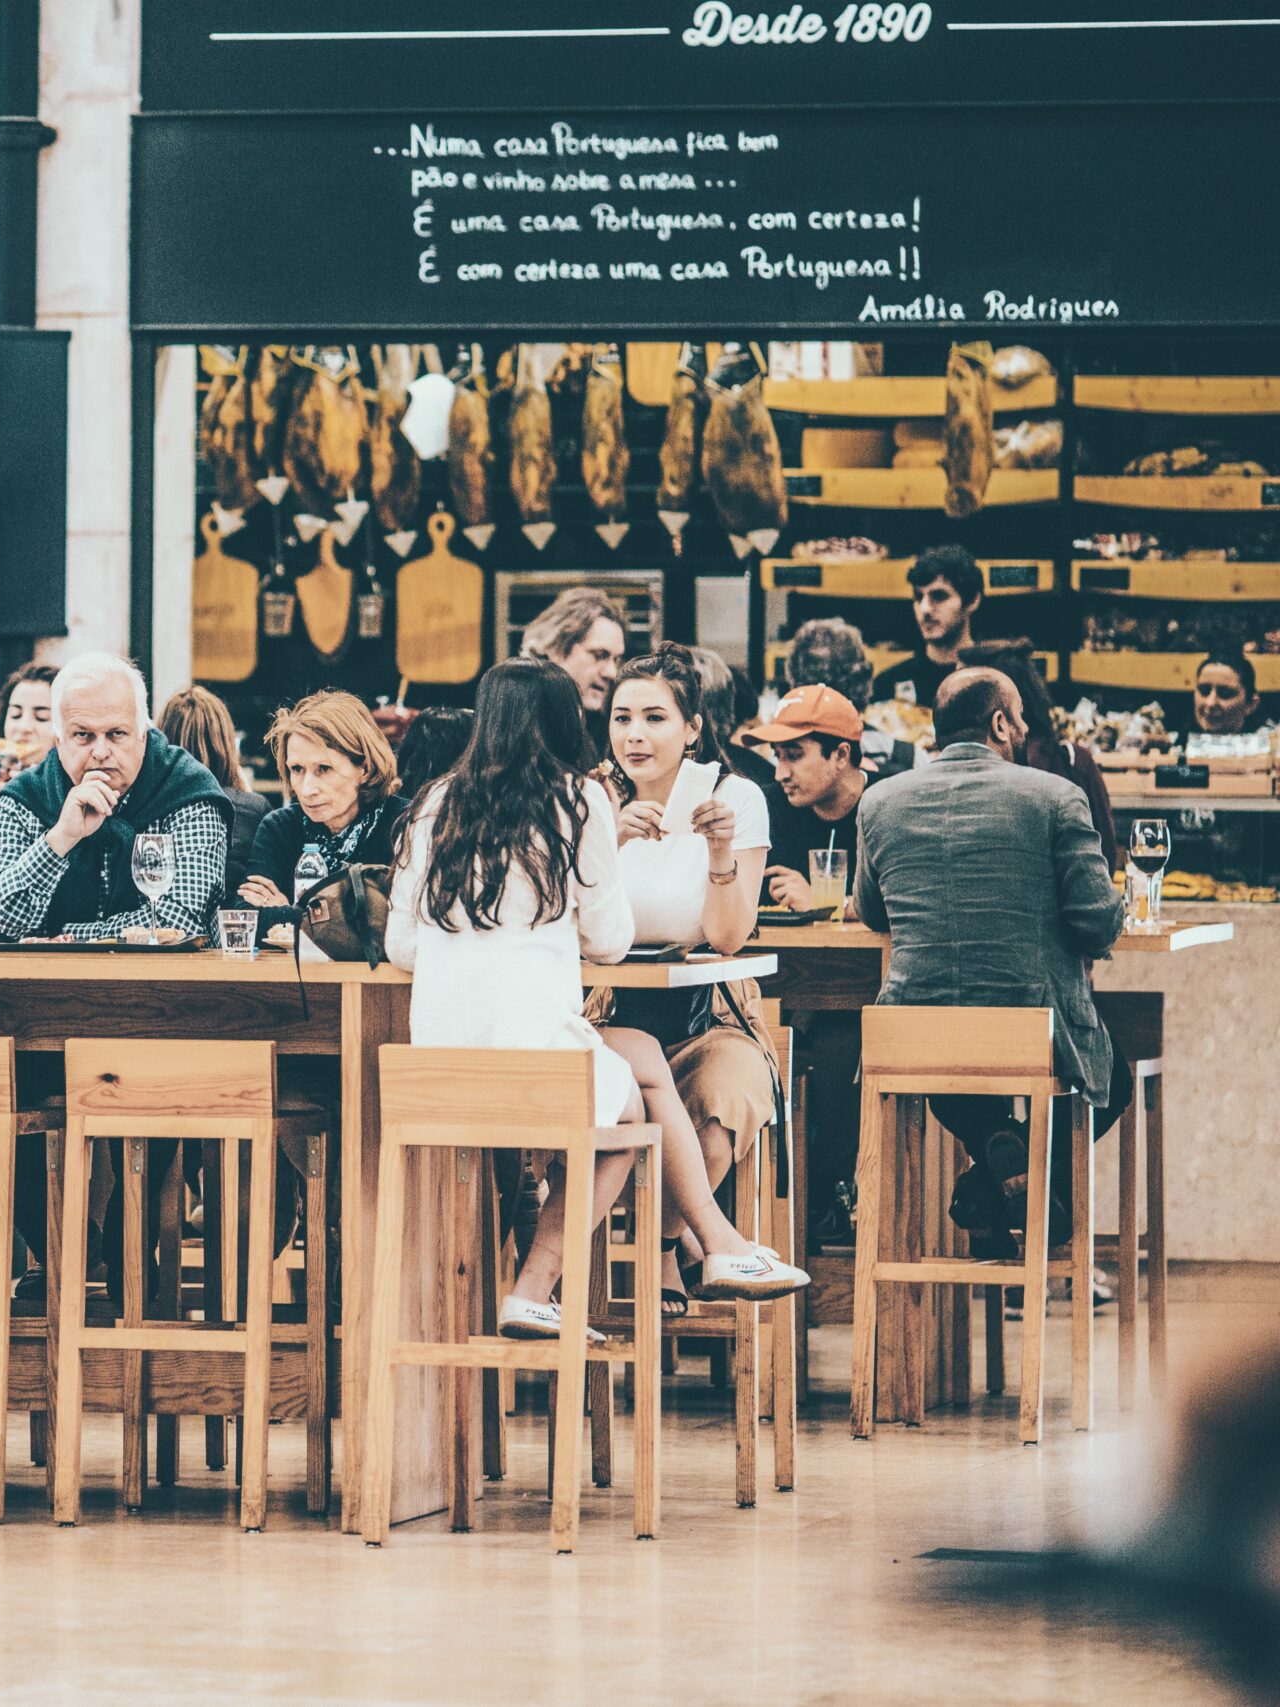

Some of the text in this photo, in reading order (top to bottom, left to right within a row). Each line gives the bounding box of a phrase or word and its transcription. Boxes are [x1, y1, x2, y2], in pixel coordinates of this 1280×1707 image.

[682, 1, 932, 47] Desde 1890
[494, 138, 549, 157] casa
[552, 122, 679, 160] Portuguesa
[686, 132, 729, 157] fica
[738, 132, 778, 152] bem
[411, 166, 458, 197] pão
[462, 173, 477, 189] e
[483, 169, 546, 192] vinho
[551, 170, 611, 192] sobre
[619, 174, 637, 190] a
[639, 172, 696, 190] mesa
[413, 198, 434, 237] É
[451, 215, 507, 233] uma
[520, 215, 580, 232] casa
[748, 212, 796, 230] com
[808, 197, 920, 232] certeza!
[419, 245, 440, 283] É
[457, 263, 503, 281] com
[514, 259, 600, 282] certeza
[610, 262, 661, 280] uma
[670, 261, 729, 281] casa
[983, 290, 1119, 324] Rodrigues
